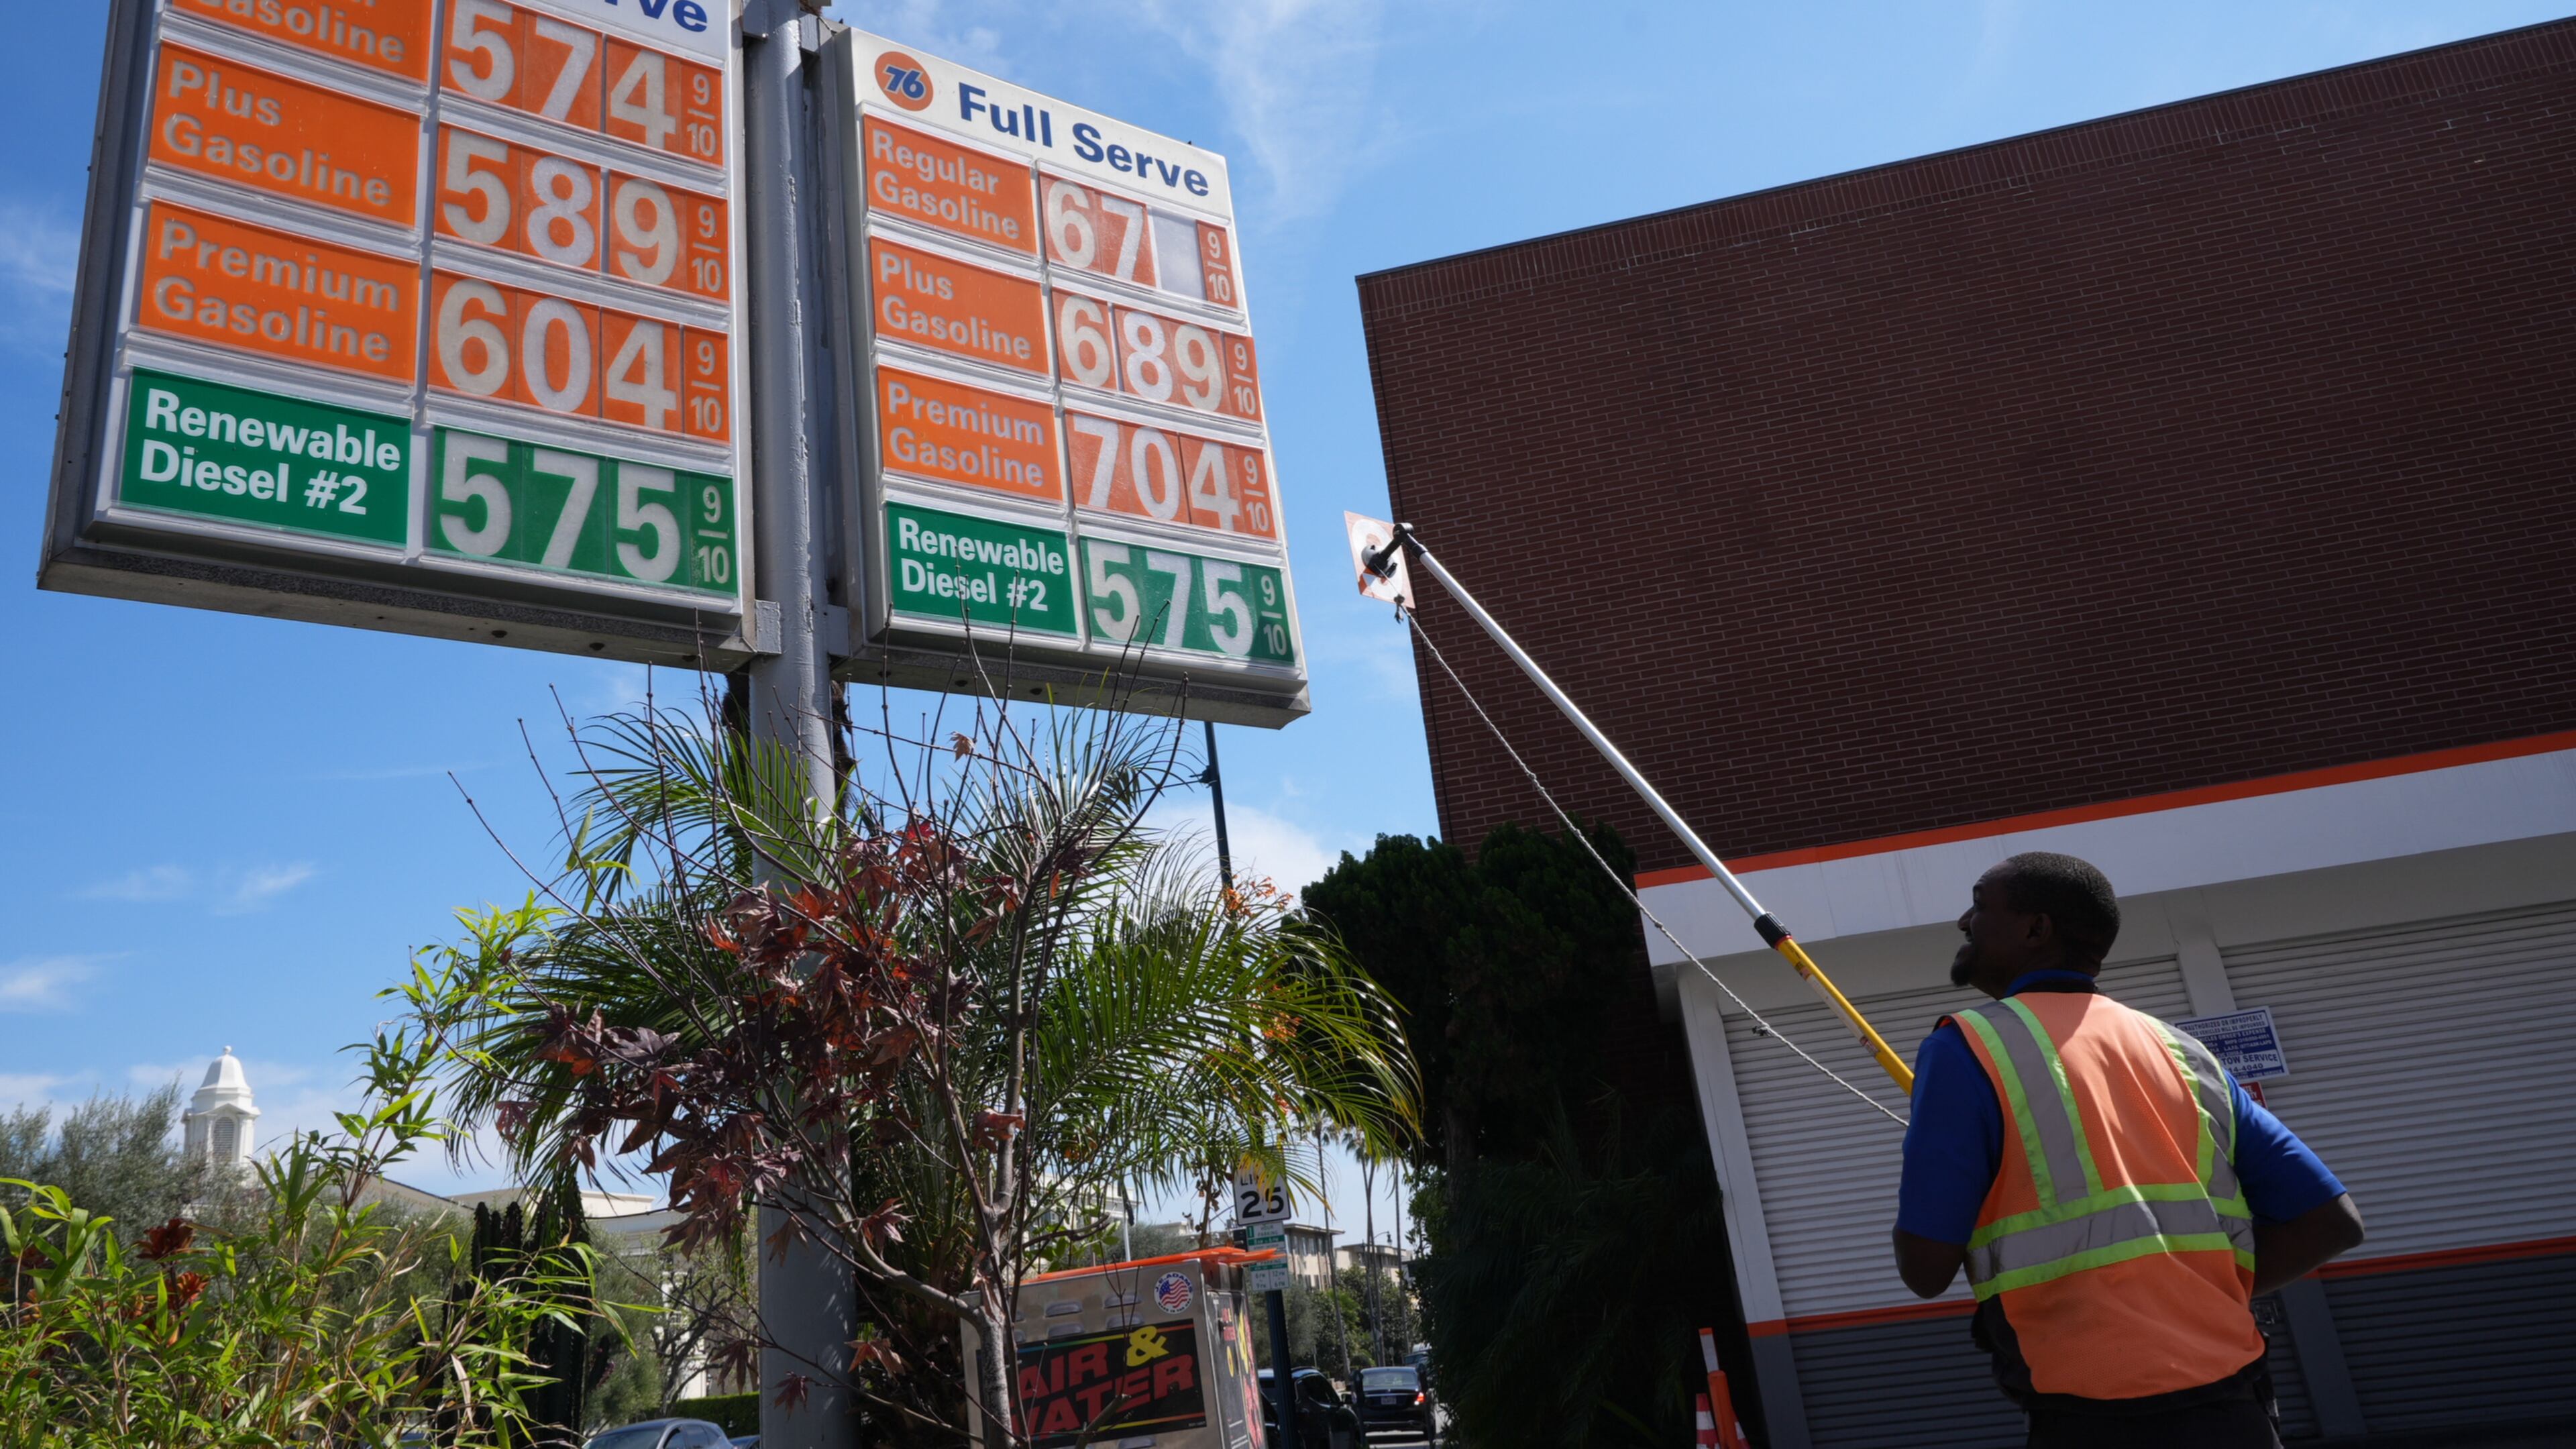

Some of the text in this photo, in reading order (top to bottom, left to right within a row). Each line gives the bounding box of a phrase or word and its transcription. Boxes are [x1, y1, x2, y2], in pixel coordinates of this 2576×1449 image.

[196, 0, 407, 63] asoline
[168, 58, 282, 127] Plus
[449, 0, 677, 150] 574
[163, 112, 392, 207] Gasoline
[873, 128, 999, 195] Regular
[884, 64, 1210, 197] 76 Full Serve
[443, 127, 679, 288] 589
[875, 170, 1020, 239] Gasoline
[1046, 179, 1144, 281] 67
[160, 217, 400, 312] Premium
[879, 251, 954, 301] Plus
[154, 275, 391, 362] Gasoline
[437, 278, 678, 430] 604
[882, 294, 1032, 360] Gasoline
[1061, 294, 1223, 413] 689
[145, 387, 401, 471] Renewable
[888, 380, 1044, 446] Premium
[140, 439, 368, 516] Diesel #2
[890, 427, 1044, 487] Gasoline
[1073, 414, 1241, 531] 704
[439, 429, 681, 583] 575
[898, 516, 1065, 576] Renewable
[900, 557, 1049, 612] Diesel #2
[1087, 537, 1253, 657] 575
[2221, 1056, 2241, 1065] TOW
[2243, 1053, 2278, 1063] SERVICE
[2229, 1014, 2263, 1025] IMPROPERLY
[1240, 1186, 1285, 1219] 25
[1008, 1325, 1170, 1409] AIR &
